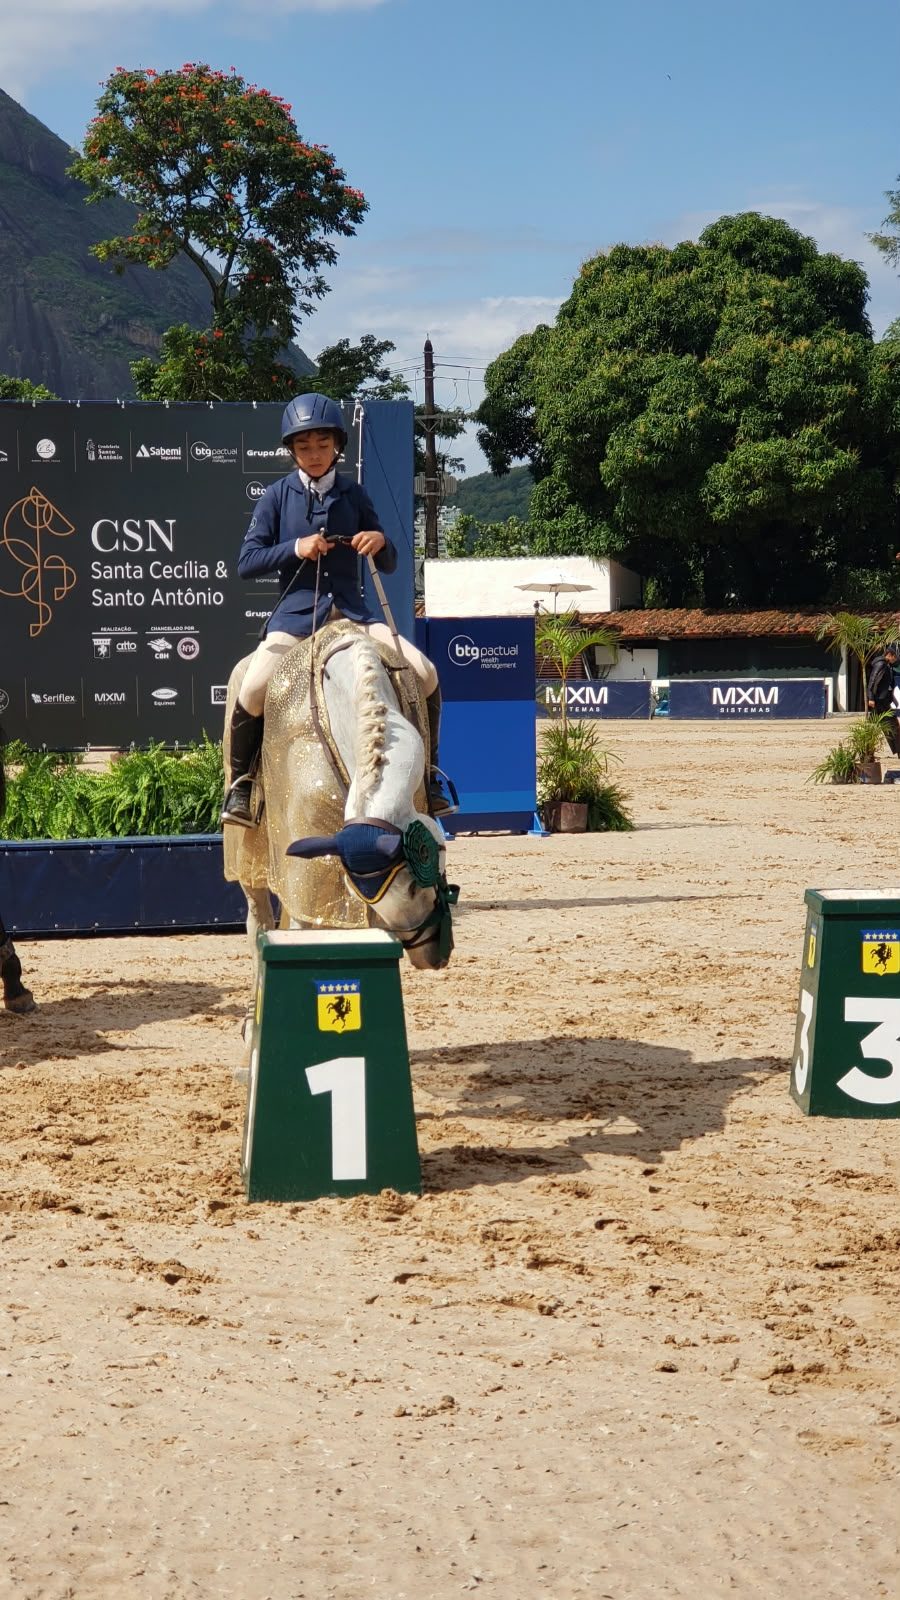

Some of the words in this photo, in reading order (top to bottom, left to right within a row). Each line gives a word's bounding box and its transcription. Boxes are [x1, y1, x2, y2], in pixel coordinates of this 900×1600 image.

[149, 446, 182, 456] Sabemi
[246, 449, 275, 458] Grupo
[90, 518, 177, 553] CSN
[90, 561, 143, 580] Santa
[149, 560, 209, 580] Cecília
[215, 560, 228, 579] &
[91, 588, 145, 607] Santo
[151, 587, 224, 607] Antônio
[42, 693, 76, 703] Seriflex
[94, 693, 126, 702] MXM
[545, 686, 609, 705] MXM
[712, 687, 779, 706] MXM
[836, 996, 900, 1105] 3
[304, 1056, 367, 1181] 1
